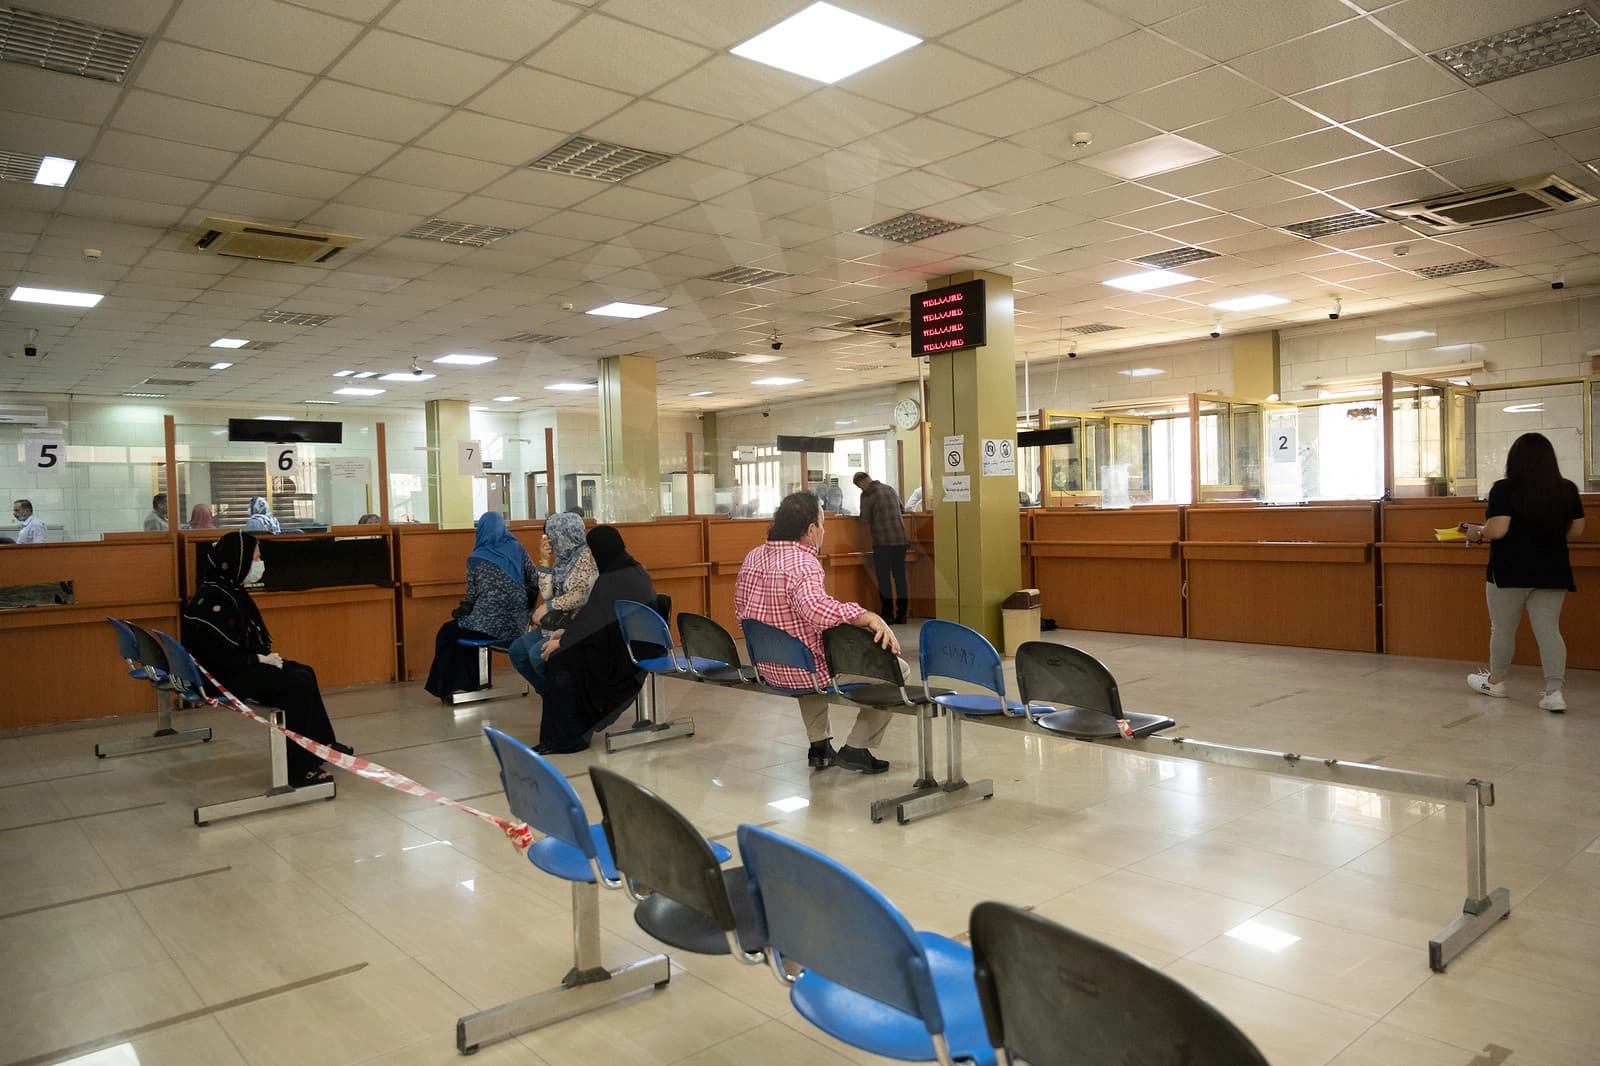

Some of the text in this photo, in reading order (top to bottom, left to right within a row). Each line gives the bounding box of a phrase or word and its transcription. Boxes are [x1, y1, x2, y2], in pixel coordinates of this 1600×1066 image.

[1278, 435, 1289, 450] 2
[37, 444, 58, 468] 5
[278, 449, 294, 471] 6
[466, 448, 474, 460] 7
